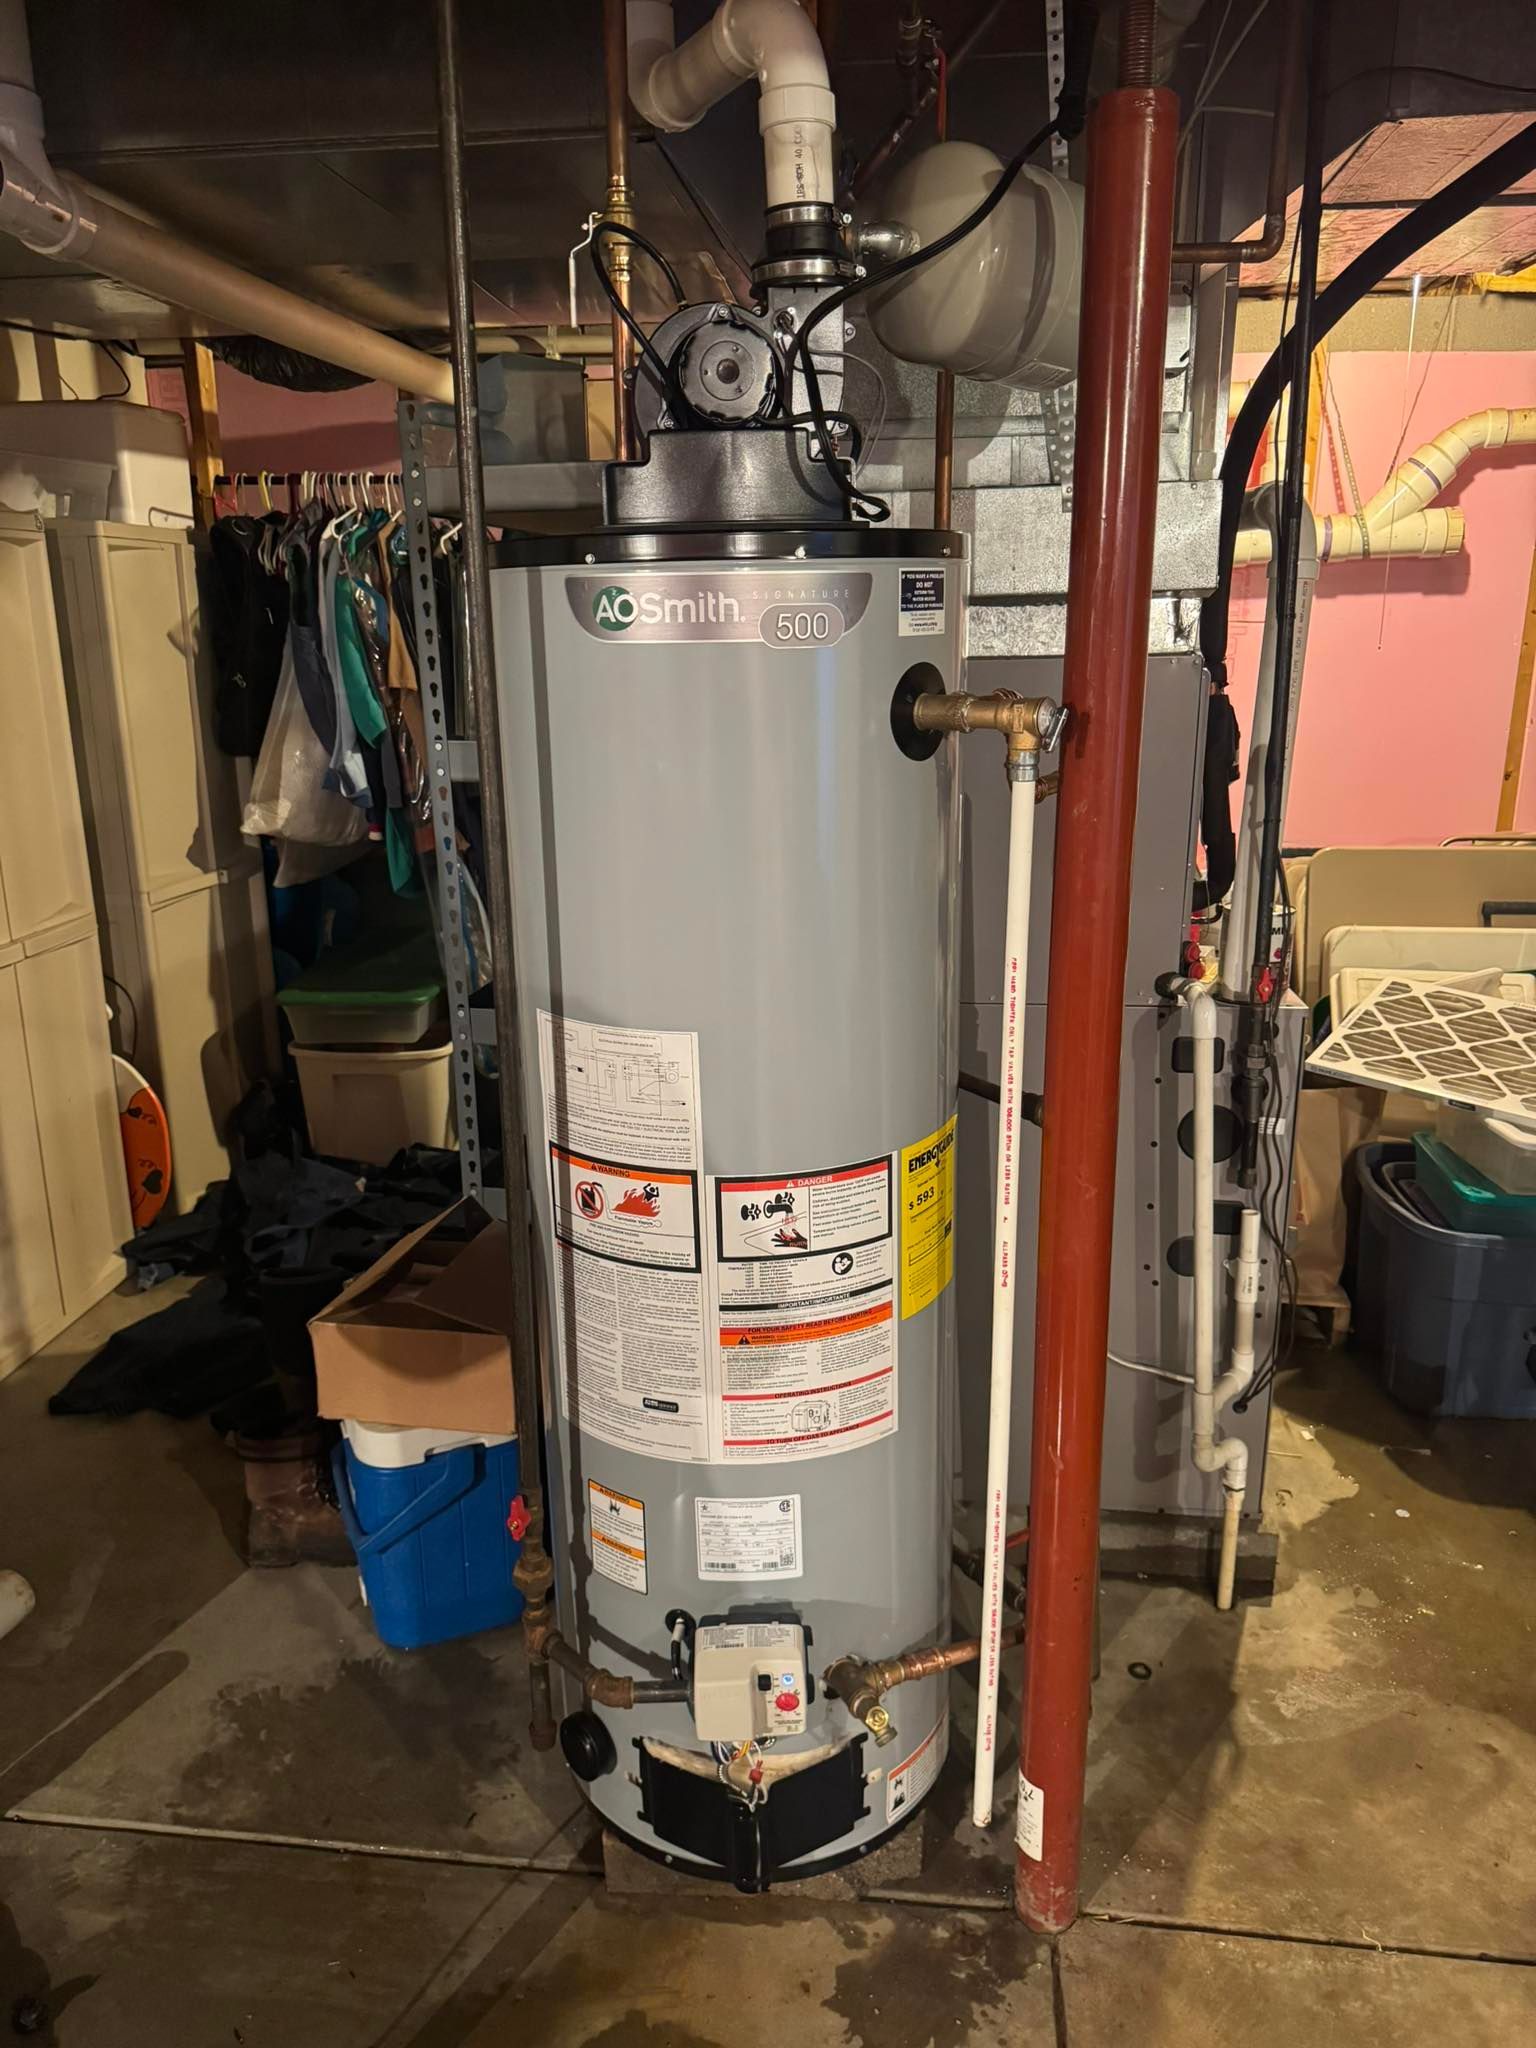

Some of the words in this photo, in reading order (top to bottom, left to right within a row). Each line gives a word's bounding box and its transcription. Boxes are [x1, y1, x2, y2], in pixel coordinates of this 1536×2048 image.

[751, 588, 850, 601] SIGNATURE
[775, 612, 829, 641] 500
[598, 1164, 630, 1178] WARNING
[797, 1175, 833, 1188] DANGER
[916, 1186, 934, 1206] 593
[774, 1390, 810, 1399] OPERATING
[830, 1424, 860, 1436] APPLIANCE
